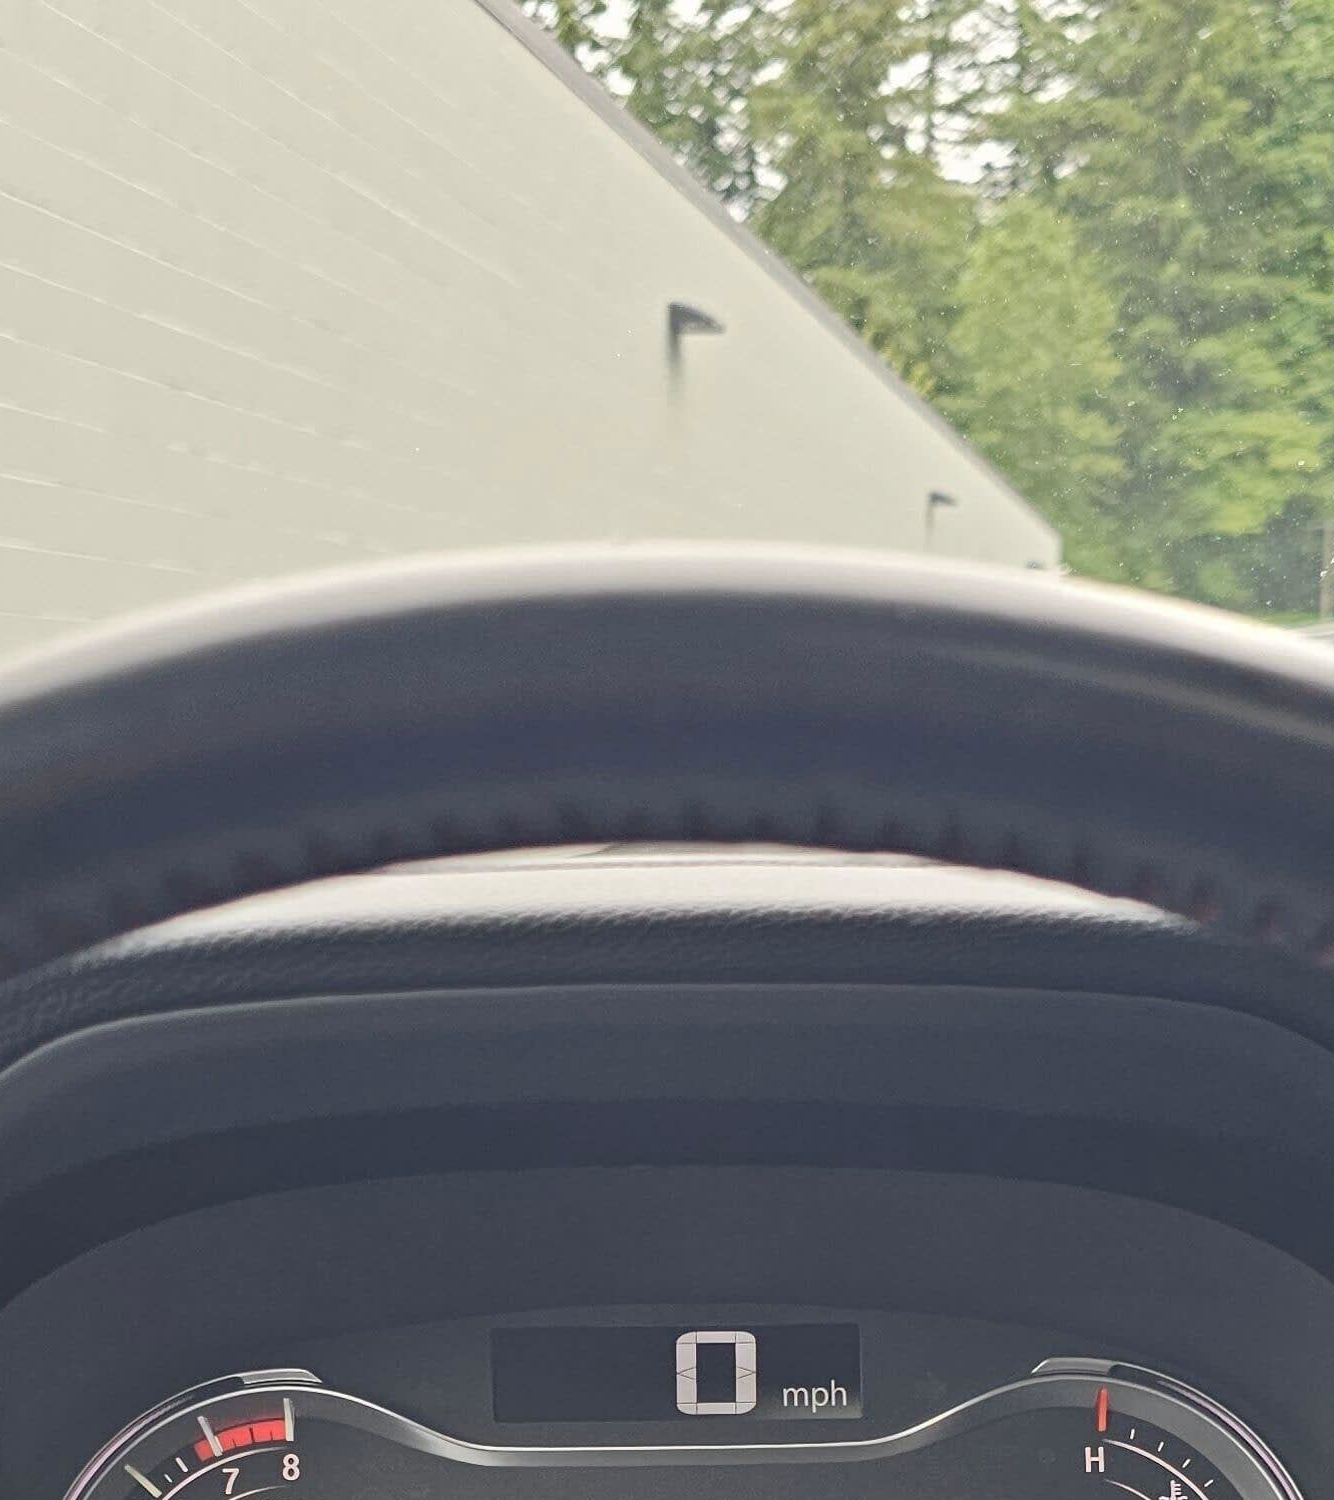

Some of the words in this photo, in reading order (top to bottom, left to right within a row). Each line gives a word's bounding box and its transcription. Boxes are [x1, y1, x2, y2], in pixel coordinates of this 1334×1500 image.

[675, 1330, 757, 1415] 0
[781, 1379, 848, 1413] mph
[282, 1453, 301, 1481] 8
[1084, 1446, 1105, 1473] H
[222, 1468, 241, 1496] 7
